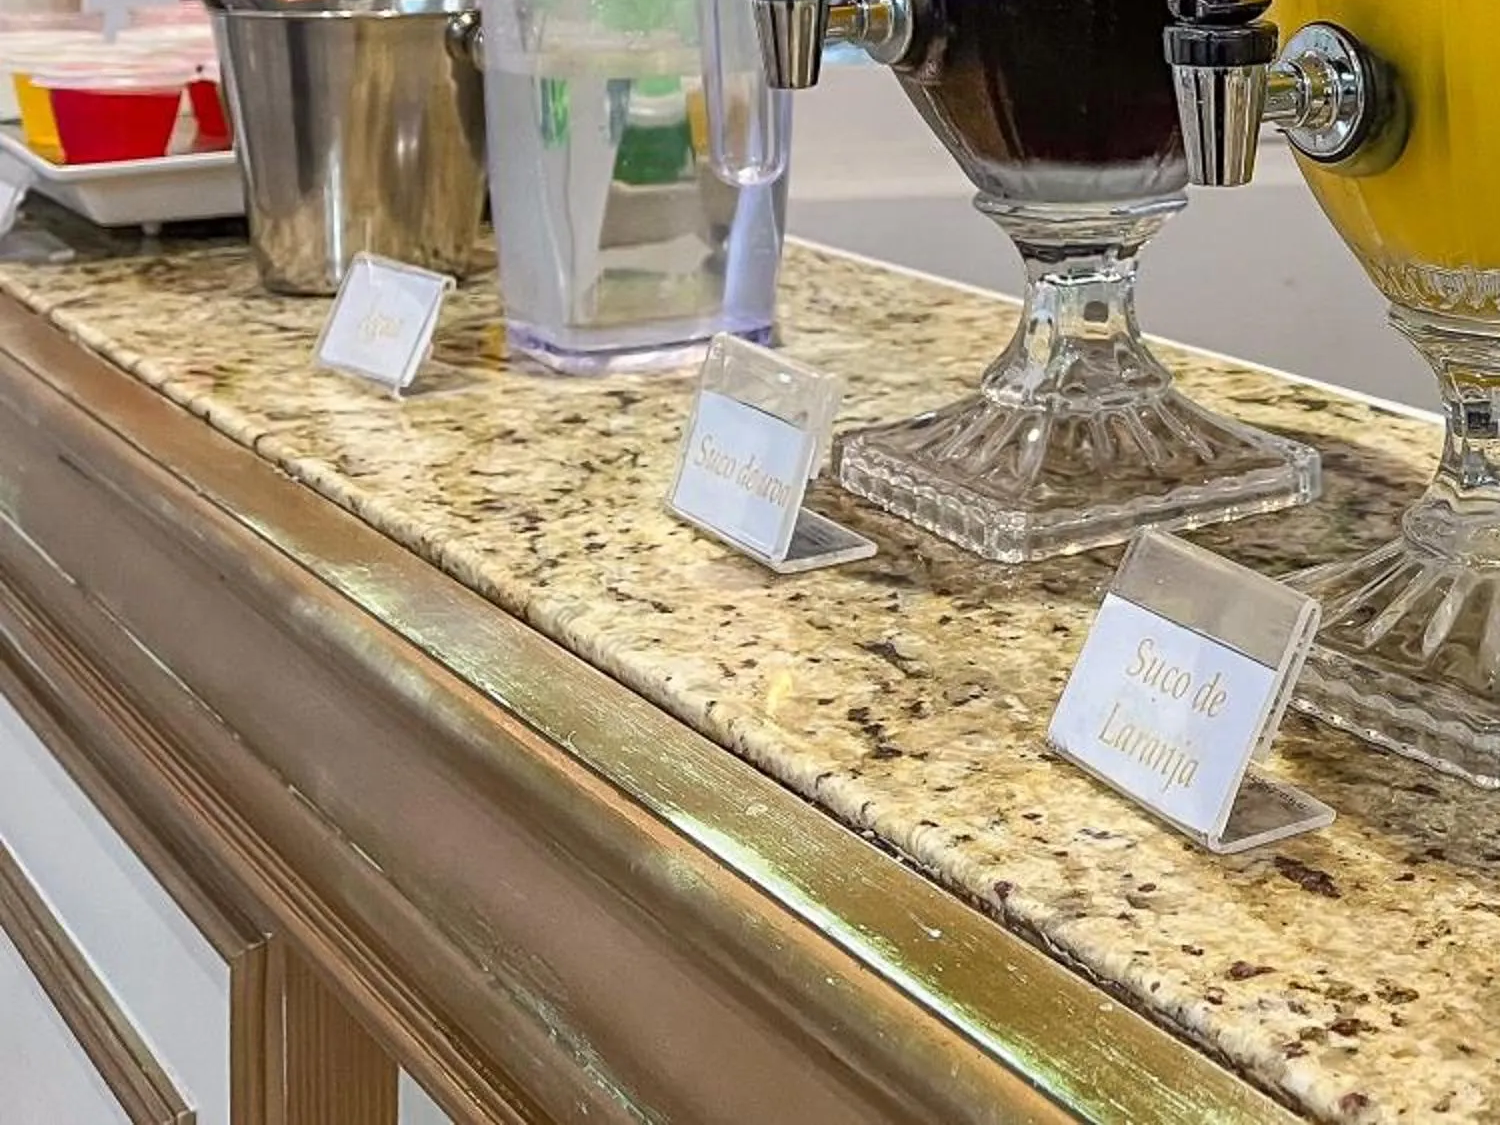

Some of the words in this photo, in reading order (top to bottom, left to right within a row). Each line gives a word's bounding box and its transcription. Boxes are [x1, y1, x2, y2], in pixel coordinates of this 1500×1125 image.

[1126, 638, 1191, 700] Suco
[1193, 672, 1227, 718] de
[1097, 702, 1199, 793] Laranja
